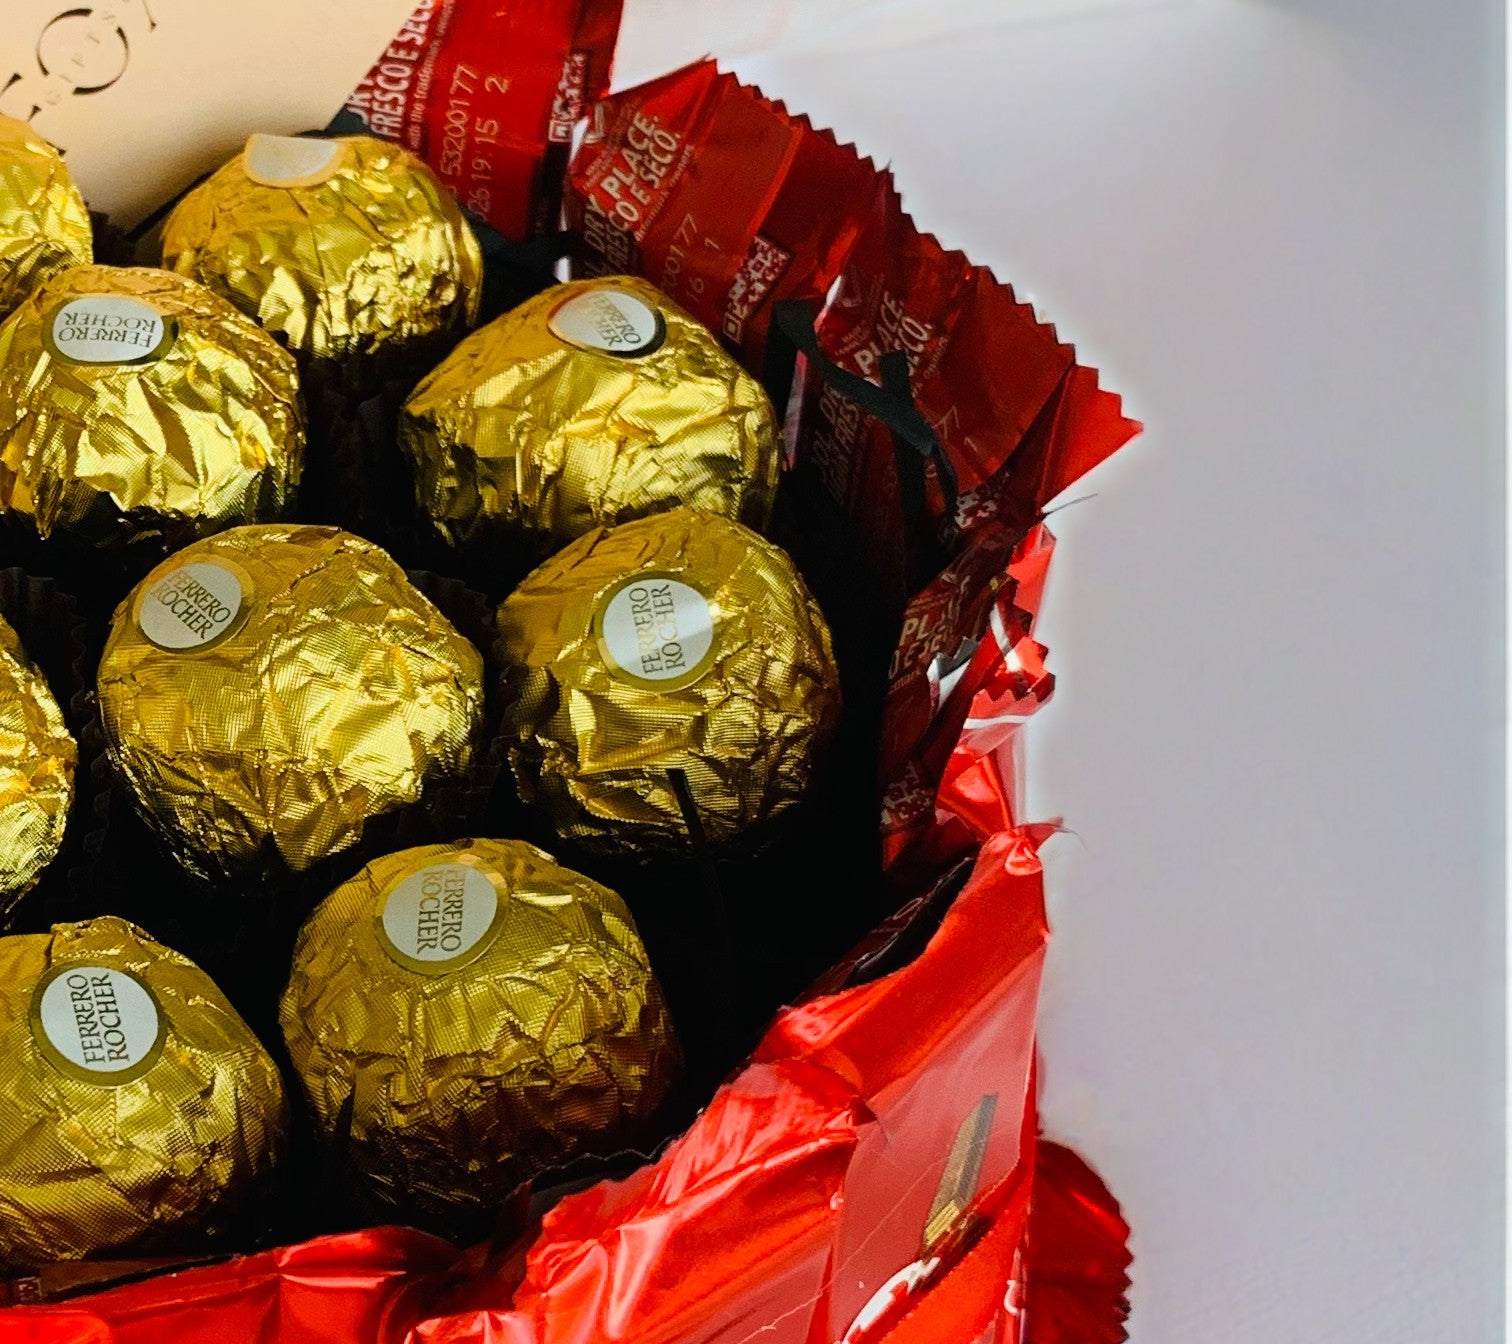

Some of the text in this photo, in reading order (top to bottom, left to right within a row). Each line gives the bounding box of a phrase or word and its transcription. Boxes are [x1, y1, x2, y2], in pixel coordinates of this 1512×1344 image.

[371, 62, 413, 138] FRESCO
[600, 112, 660, 200] PLACE.
[639, 129, 681, 190] SECO.
[58, 327, 153, 348] FERRERO
[63, 312, 156, 333] ROCHER
[416, 870, 443, 955] ROCHER
[440, 868, 466, 953] FERRERO
[66, 974, 106, 1065] FERRERO
[91, 971, 130, 1063] ROCHER
